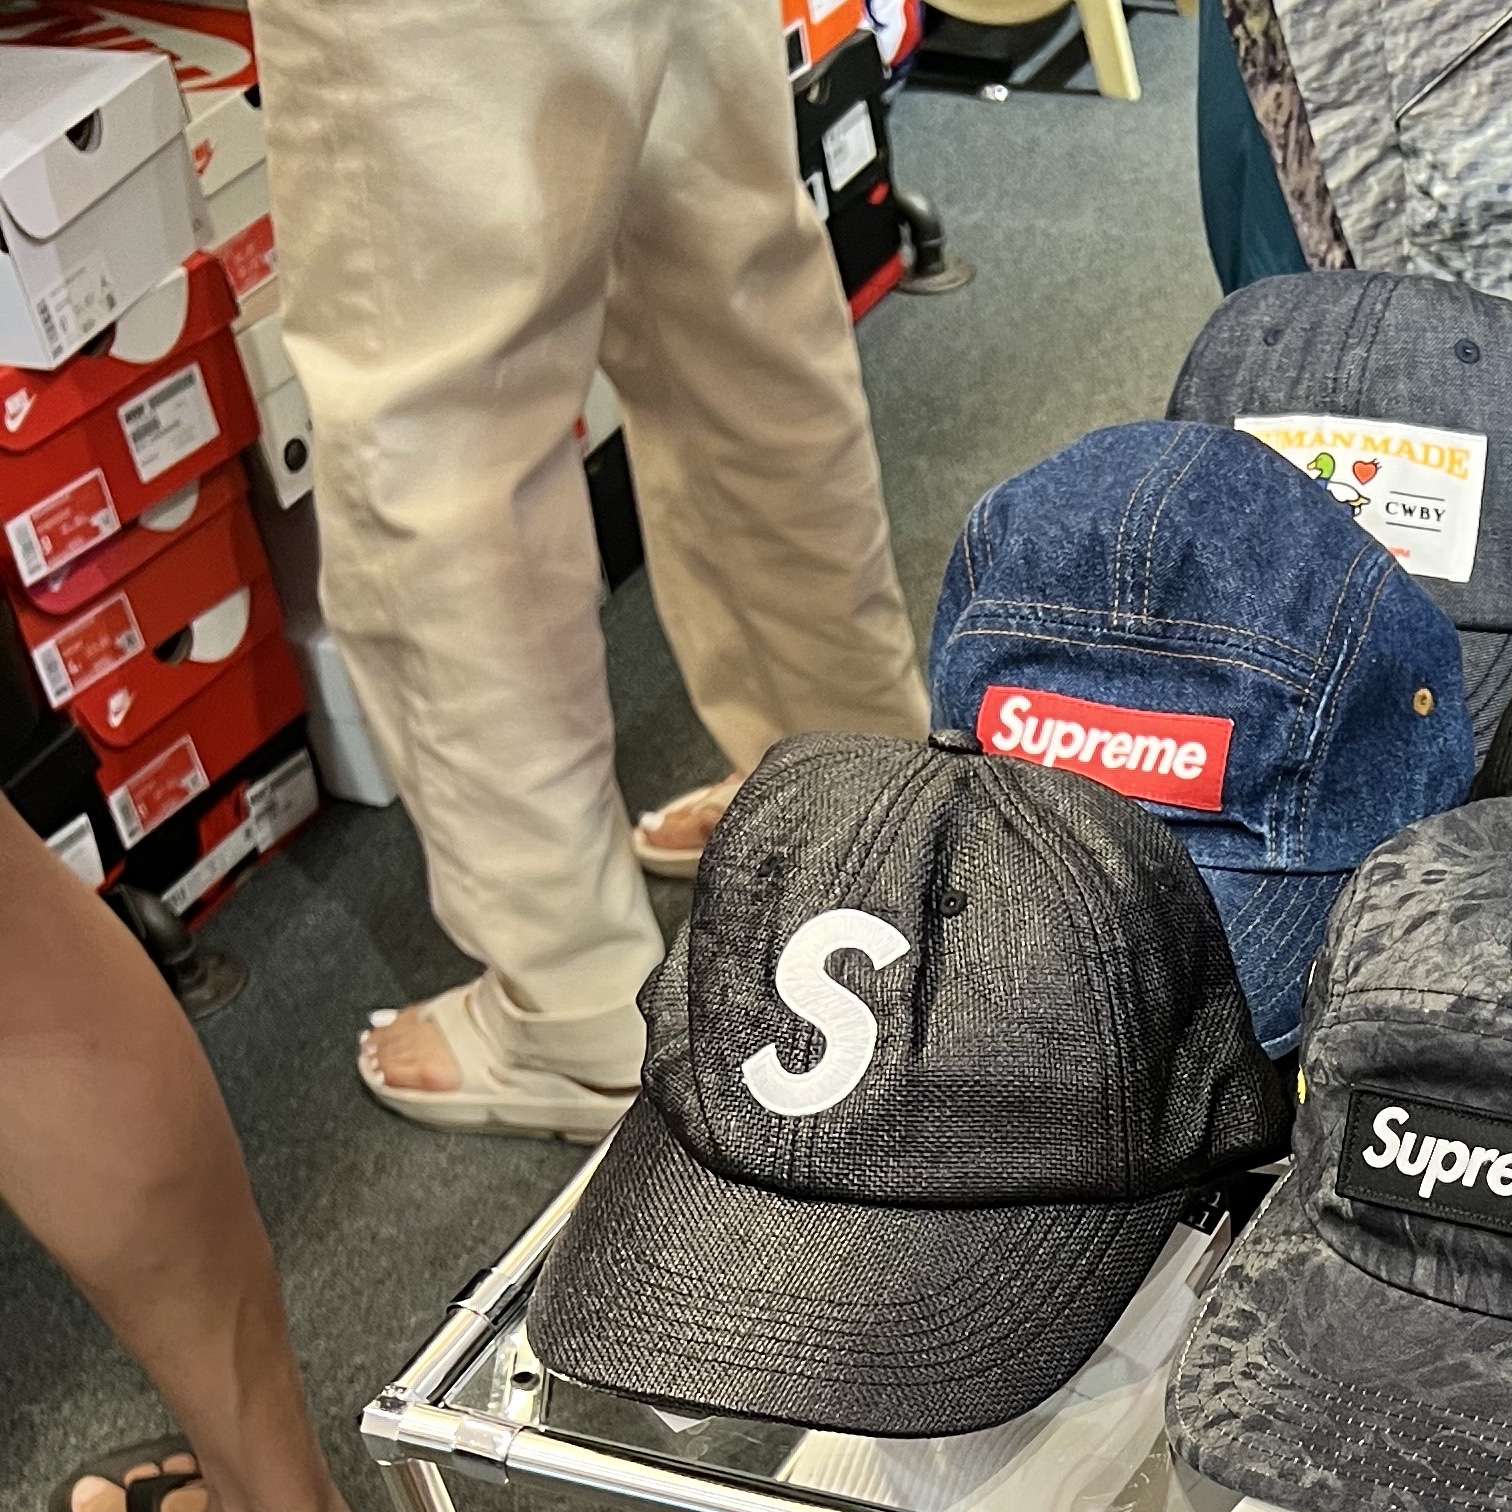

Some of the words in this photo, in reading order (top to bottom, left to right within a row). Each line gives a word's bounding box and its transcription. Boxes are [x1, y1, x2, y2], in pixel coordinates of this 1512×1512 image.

[1358, 436, 1471, 481] MADE
[1385, 501, 1446, 523] CWBY
[992, 696, 1207, 780] Supreme
[741, 908, 911, 1117] S
